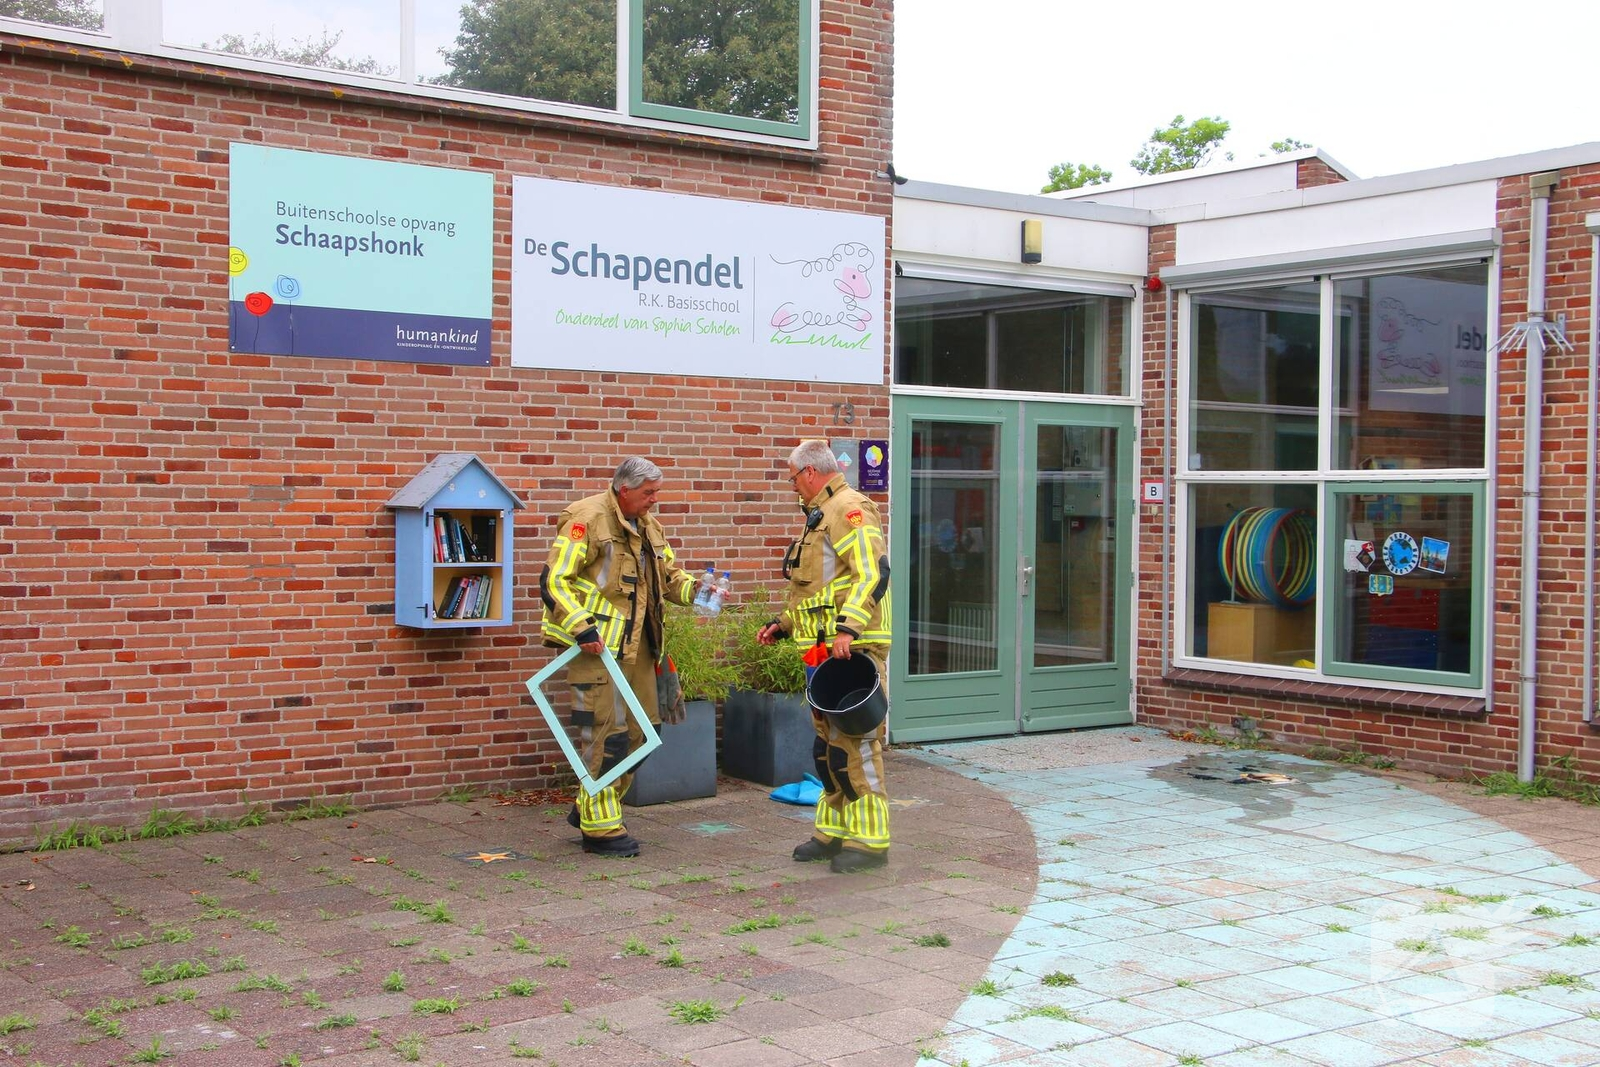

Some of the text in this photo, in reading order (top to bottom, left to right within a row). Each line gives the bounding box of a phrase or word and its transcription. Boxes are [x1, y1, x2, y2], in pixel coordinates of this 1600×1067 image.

[276, 201, 456, 237] Buitenschoolse opvang
[275, 224, 424, 257] Schaapshonk
[524, 238, 743, 291] De Schapendel
[638, 292, 740, 313] R.K. Basisschool
[396, 324, 479, 345] humankind
[555, 308, 741, 338] Onderdeel van Sophia Scholen
[832, 402, 855, 425] 73
[1150, 486, 1157, 496] B
